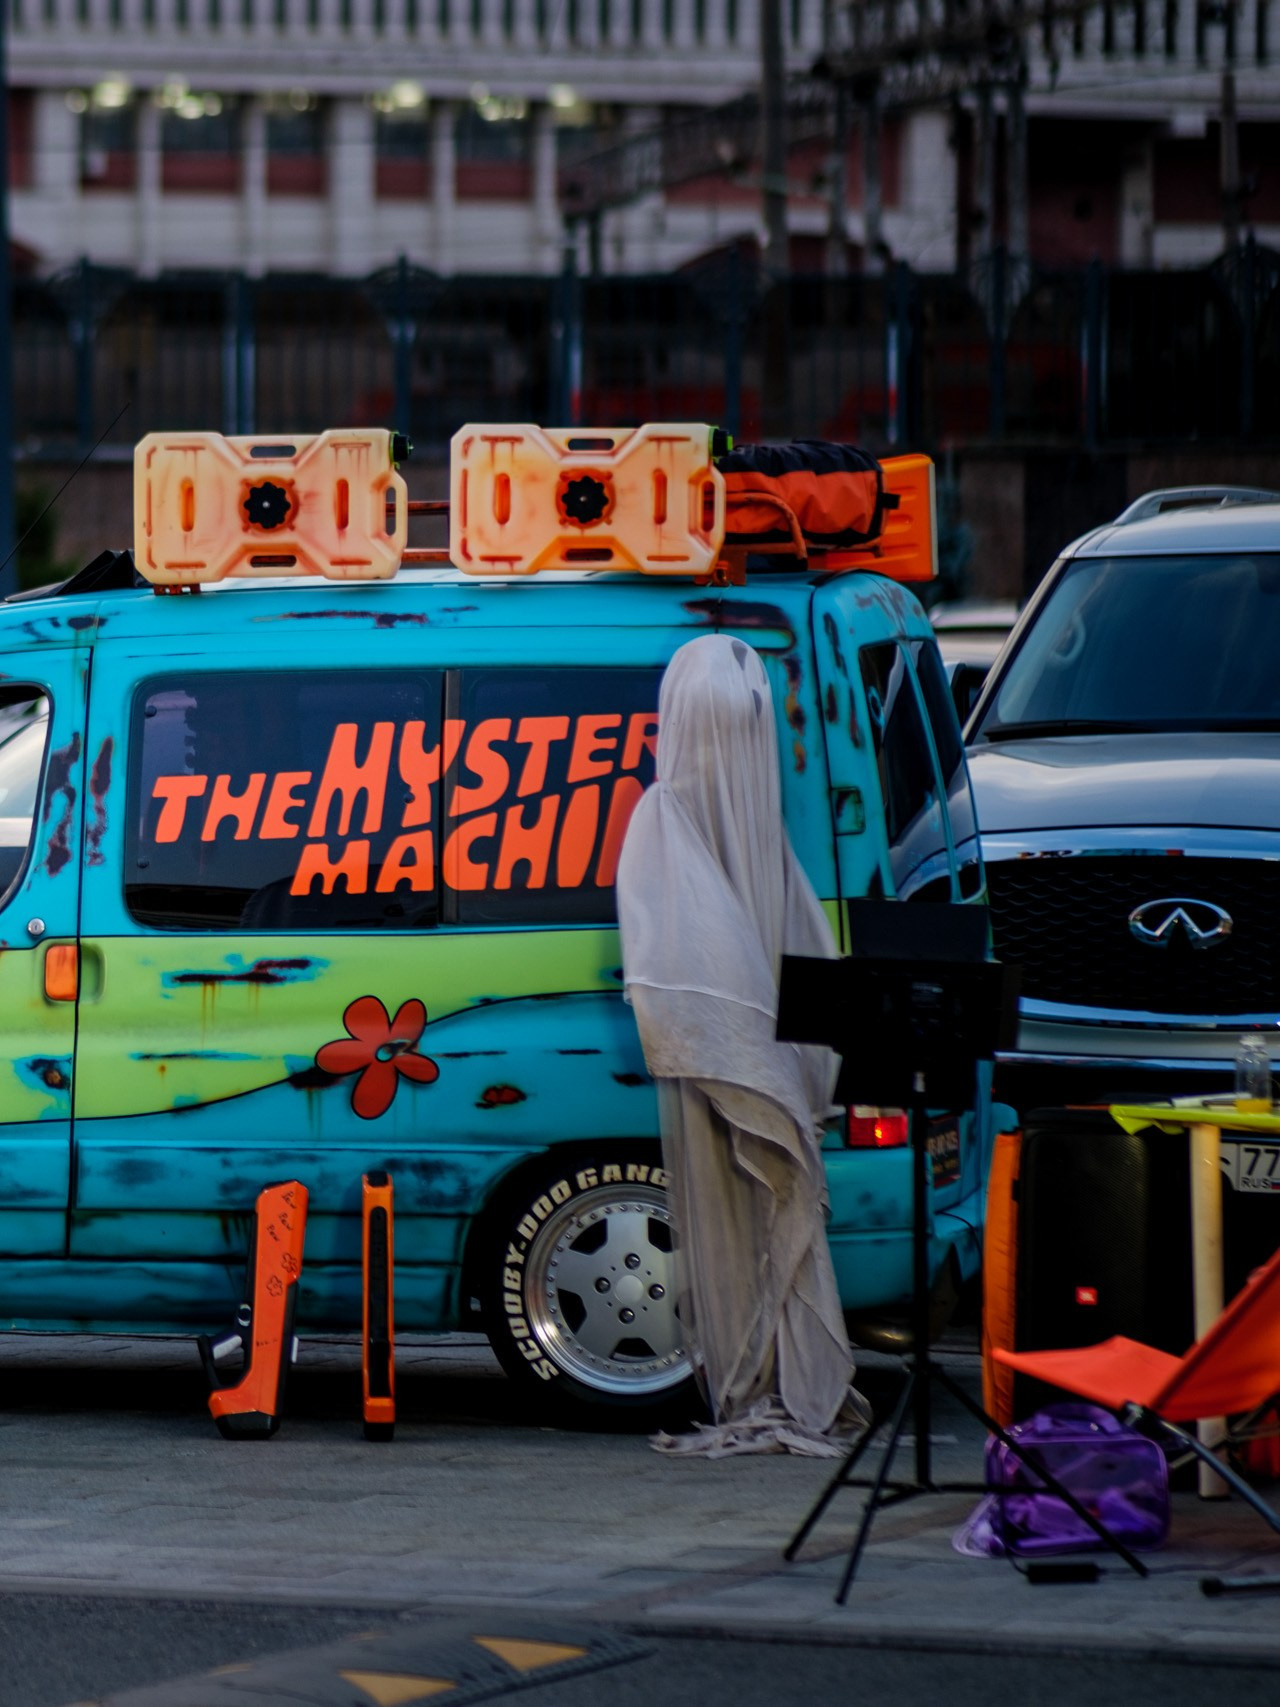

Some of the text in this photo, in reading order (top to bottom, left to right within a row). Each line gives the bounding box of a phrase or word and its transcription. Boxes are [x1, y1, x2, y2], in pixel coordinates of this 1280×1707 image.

[151, 712, 659, 843] THE MYSTER
[289, 776, 644, 896] MACHI
[1244, 1147, 1280, 1176] 77
[575, 1164, 673, 1192] GANG
[1241, 1177, 1269, 1189] RUS
